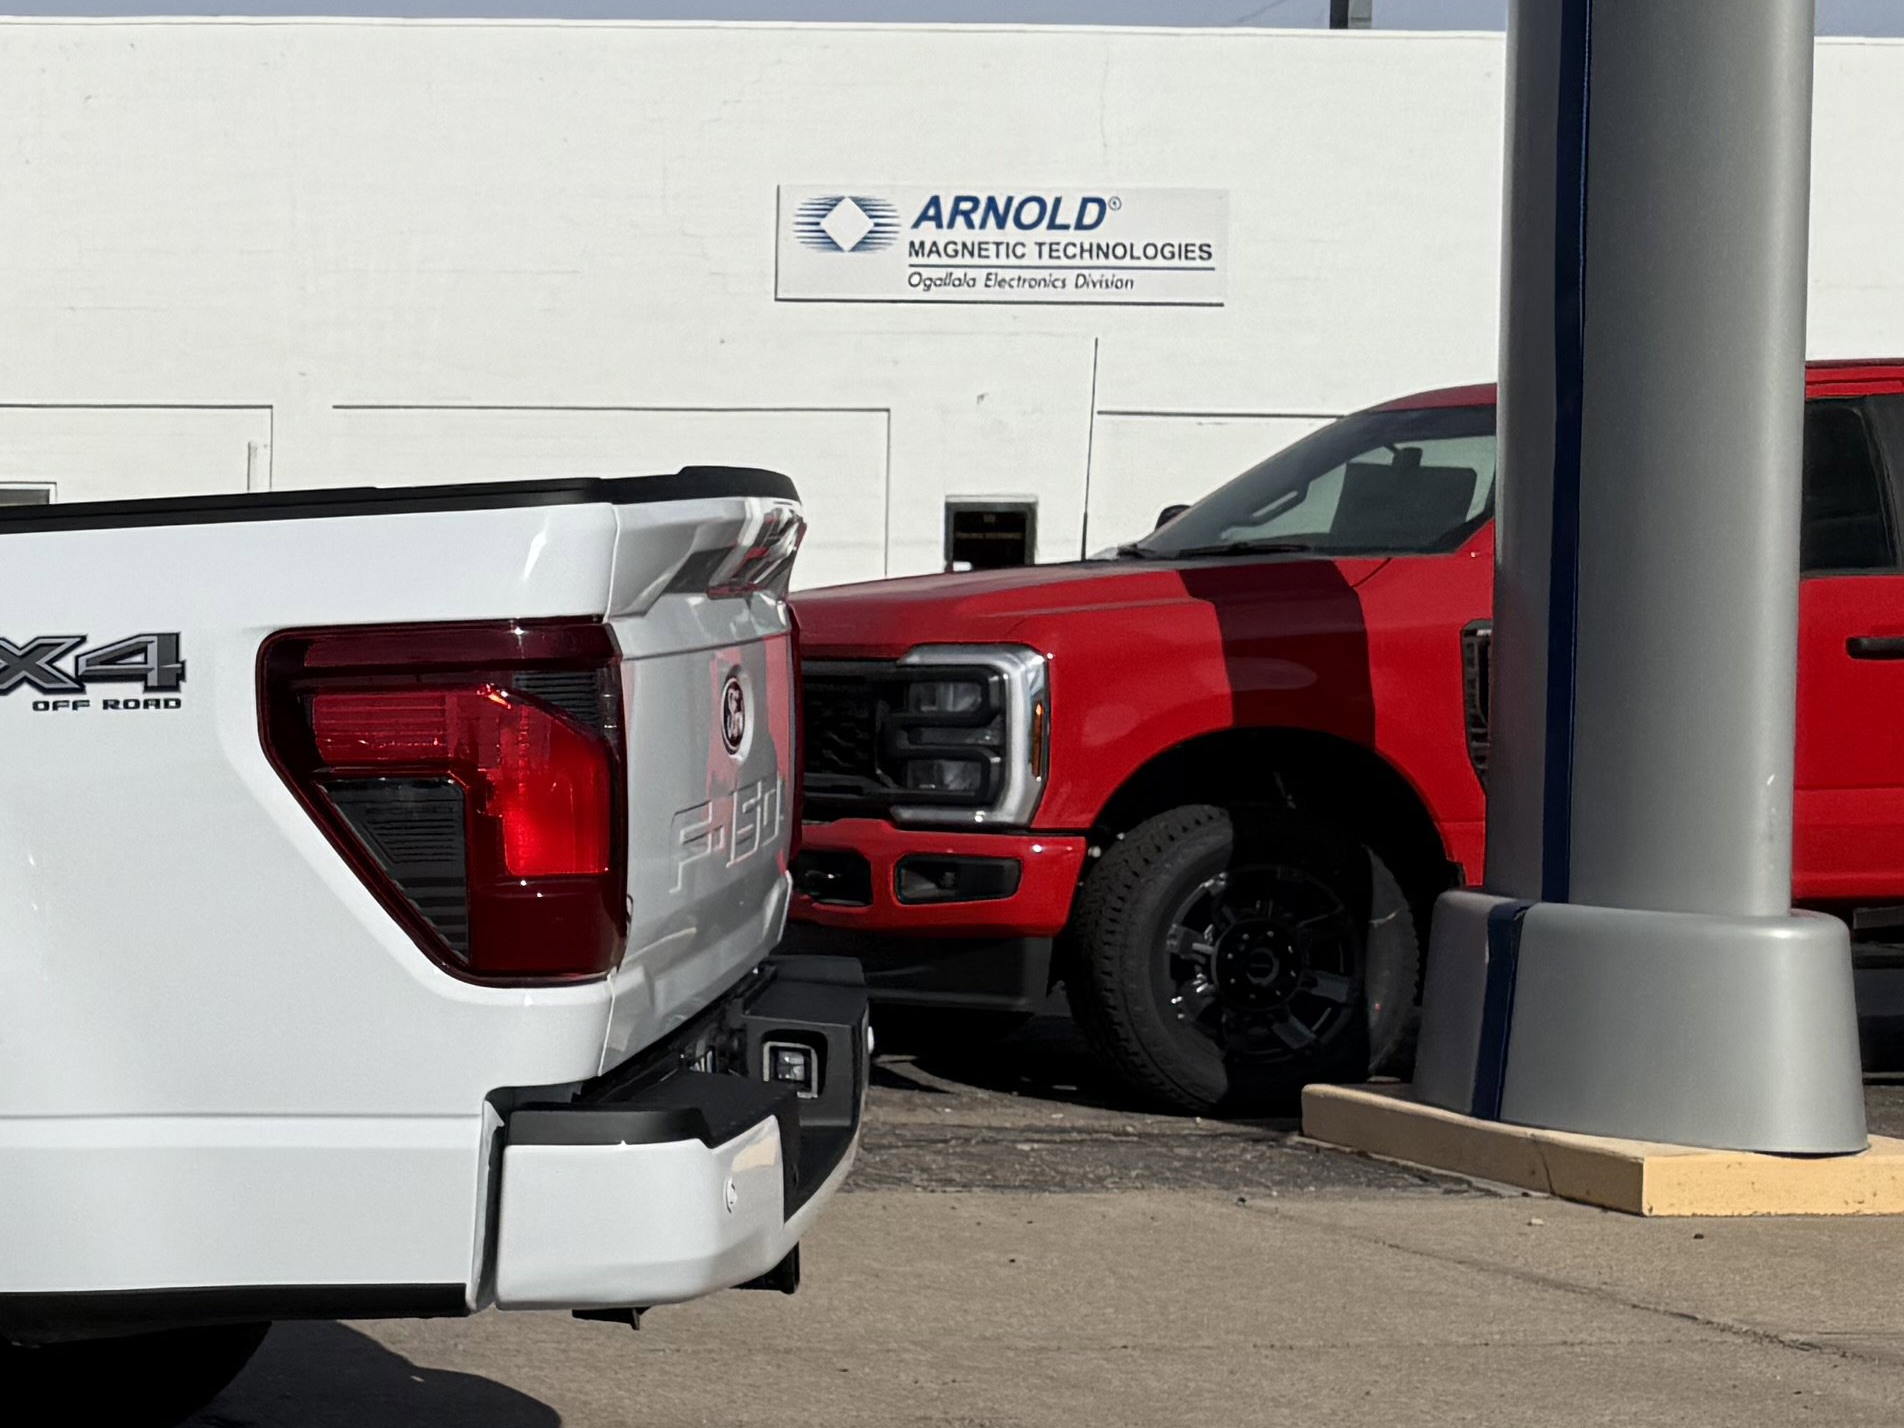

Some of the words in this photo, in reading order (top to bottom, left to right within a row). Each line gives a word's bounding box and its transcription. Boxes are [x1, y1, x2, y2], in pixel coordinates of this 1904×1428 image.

[908, 240, 1027, 260] MAGNETIC
[1034, 241, 1214, 261] TECHNOLOGIES
[907, 271, 977, 292] Ogallala
[983, 272, 1067, 290] Electronics
[1074, 273, 1135, 290] Division
[31, 699, 91, 712] OFF
[102, 697, 182, 711] ROAD
